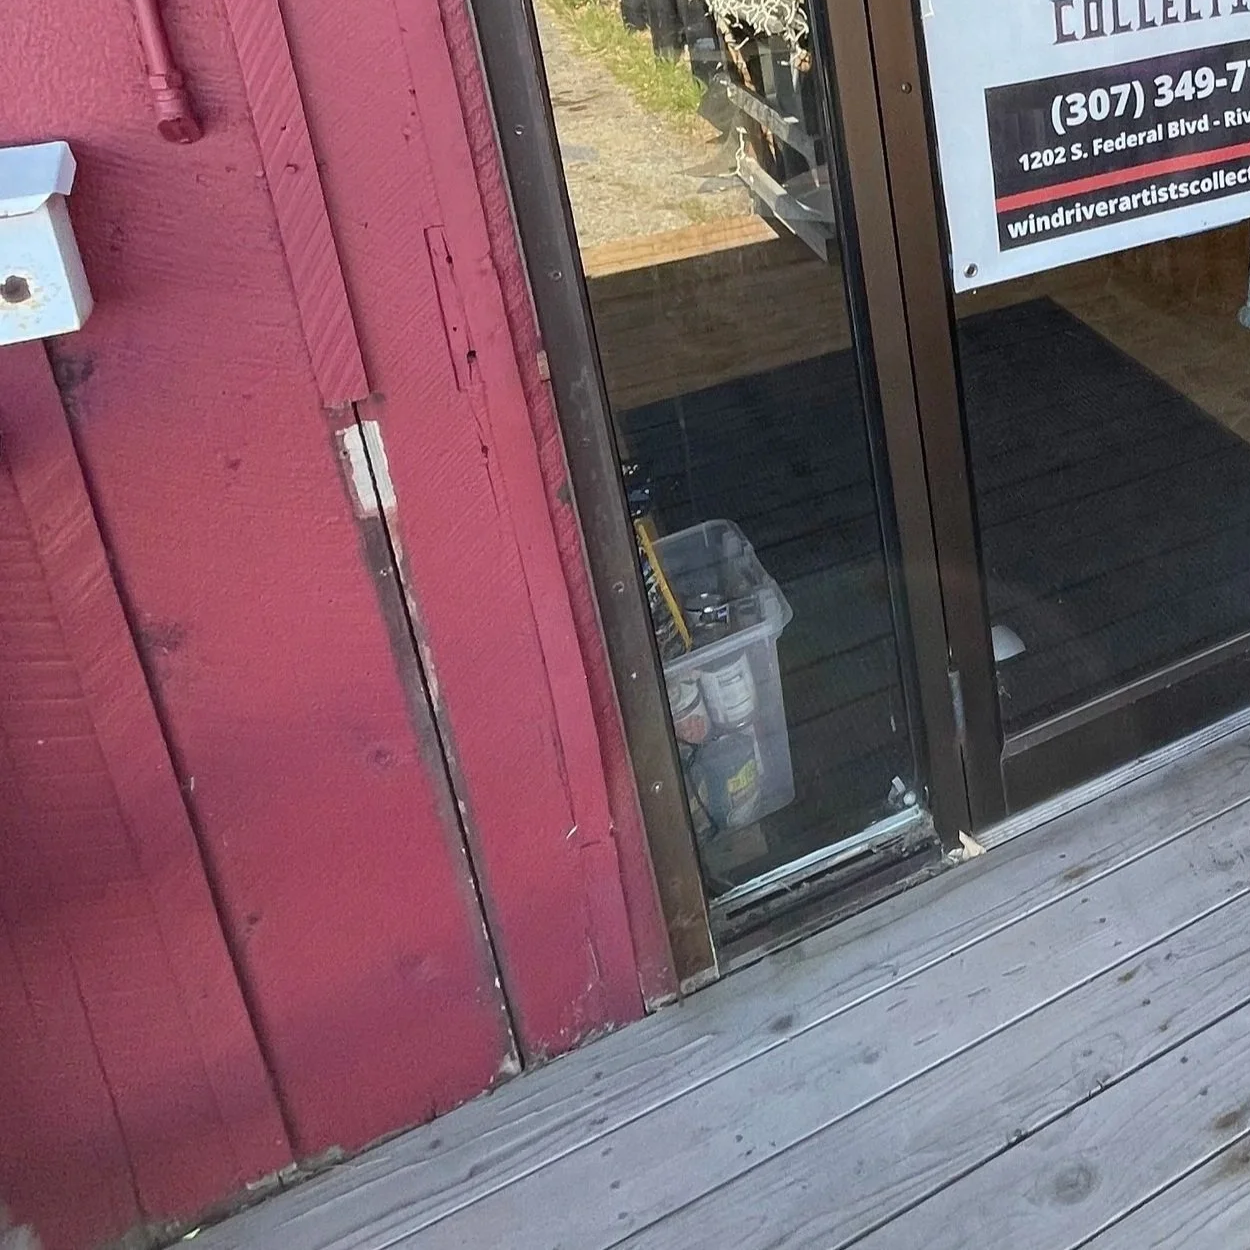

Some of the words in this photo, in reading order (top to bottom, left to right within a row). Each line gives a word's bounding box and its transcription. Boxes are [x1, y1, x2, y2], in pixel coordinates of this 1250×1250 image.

[1050, 80, 1146, 136] (307)
[1018, 145, 1067, 173] 1202
[1070, 142, 1089, 160] S.
[1092, 119, 1164, 155] Federal
[1168, 113, 1210, 139] Blvd
